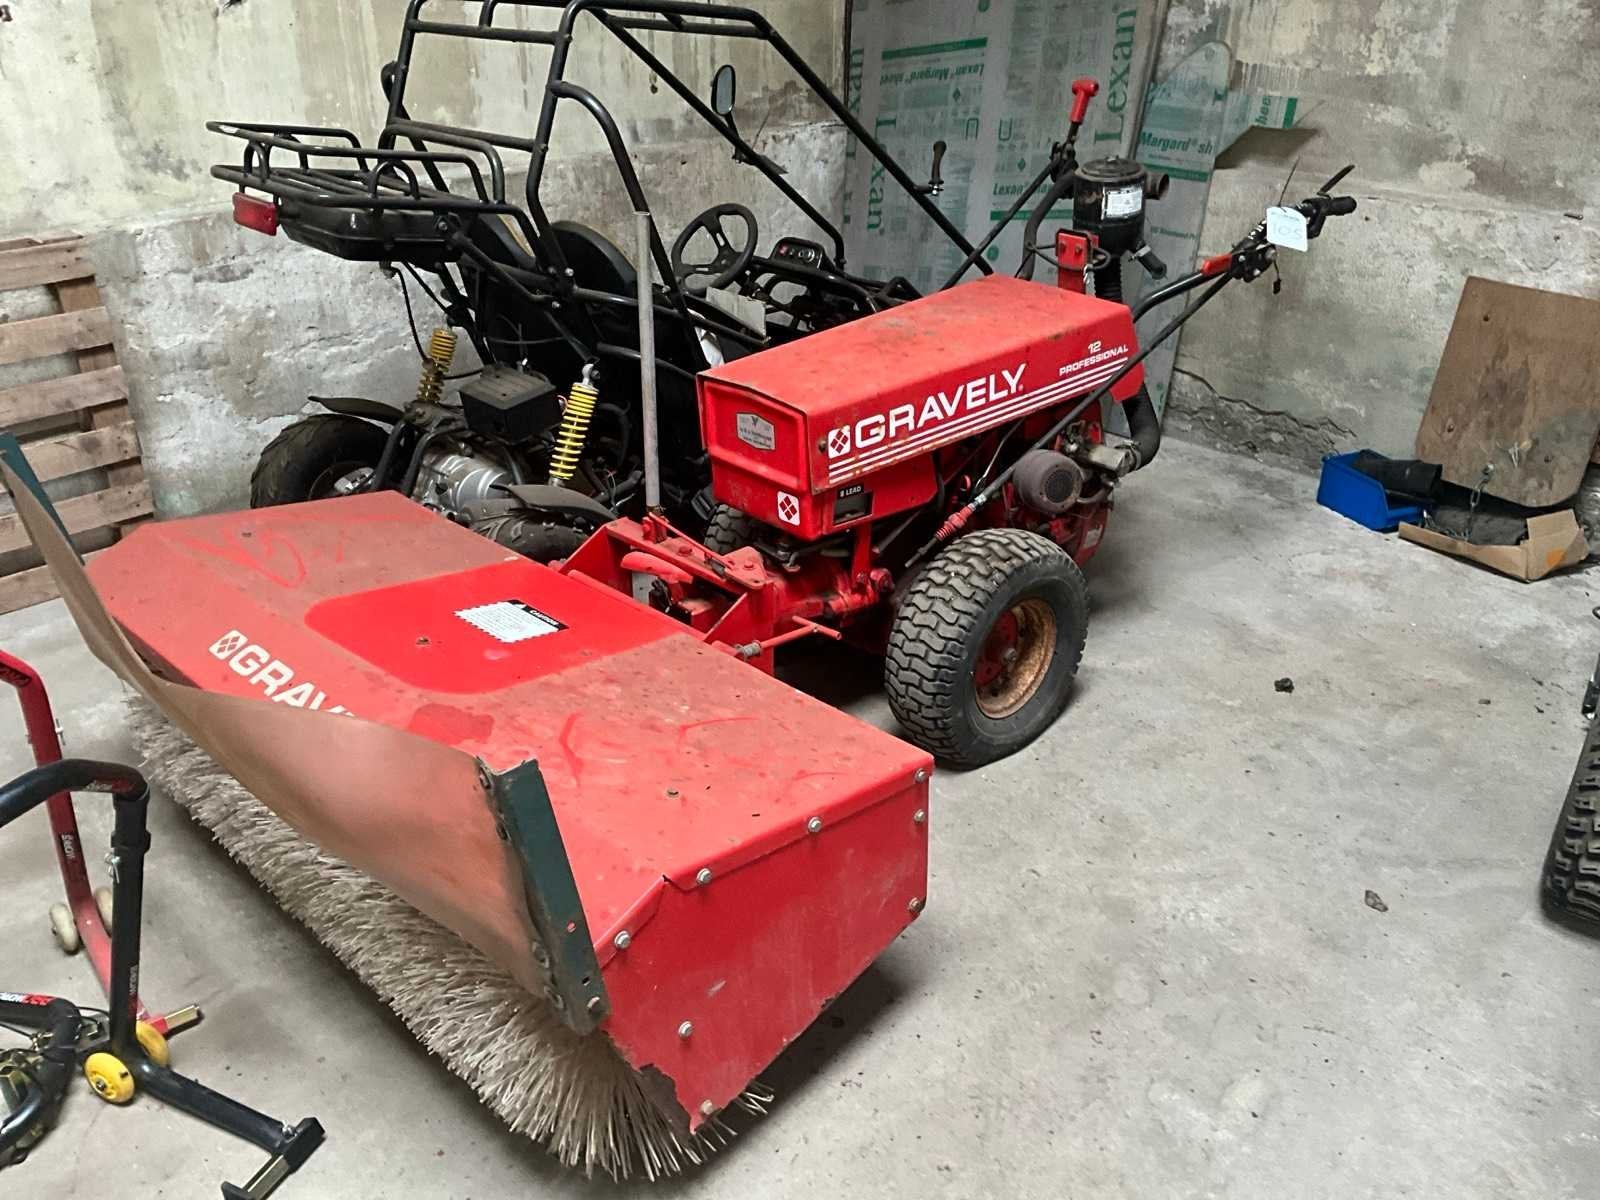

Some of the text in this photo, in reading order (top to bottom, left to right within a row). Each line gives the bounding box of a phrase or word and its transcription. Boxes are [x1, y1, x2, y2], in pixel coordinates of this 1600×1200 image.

[1094, 10, 1136, 144] Lexan
[867, 118, 898, 230] Lxan
[1059, 344, 1129, 376] PROFESSIONAL
[1088, 340, 1102, 354] 12
[855, 363, 1026, 448] GRAVELY
[229, 644, 355, 717] GRAV
